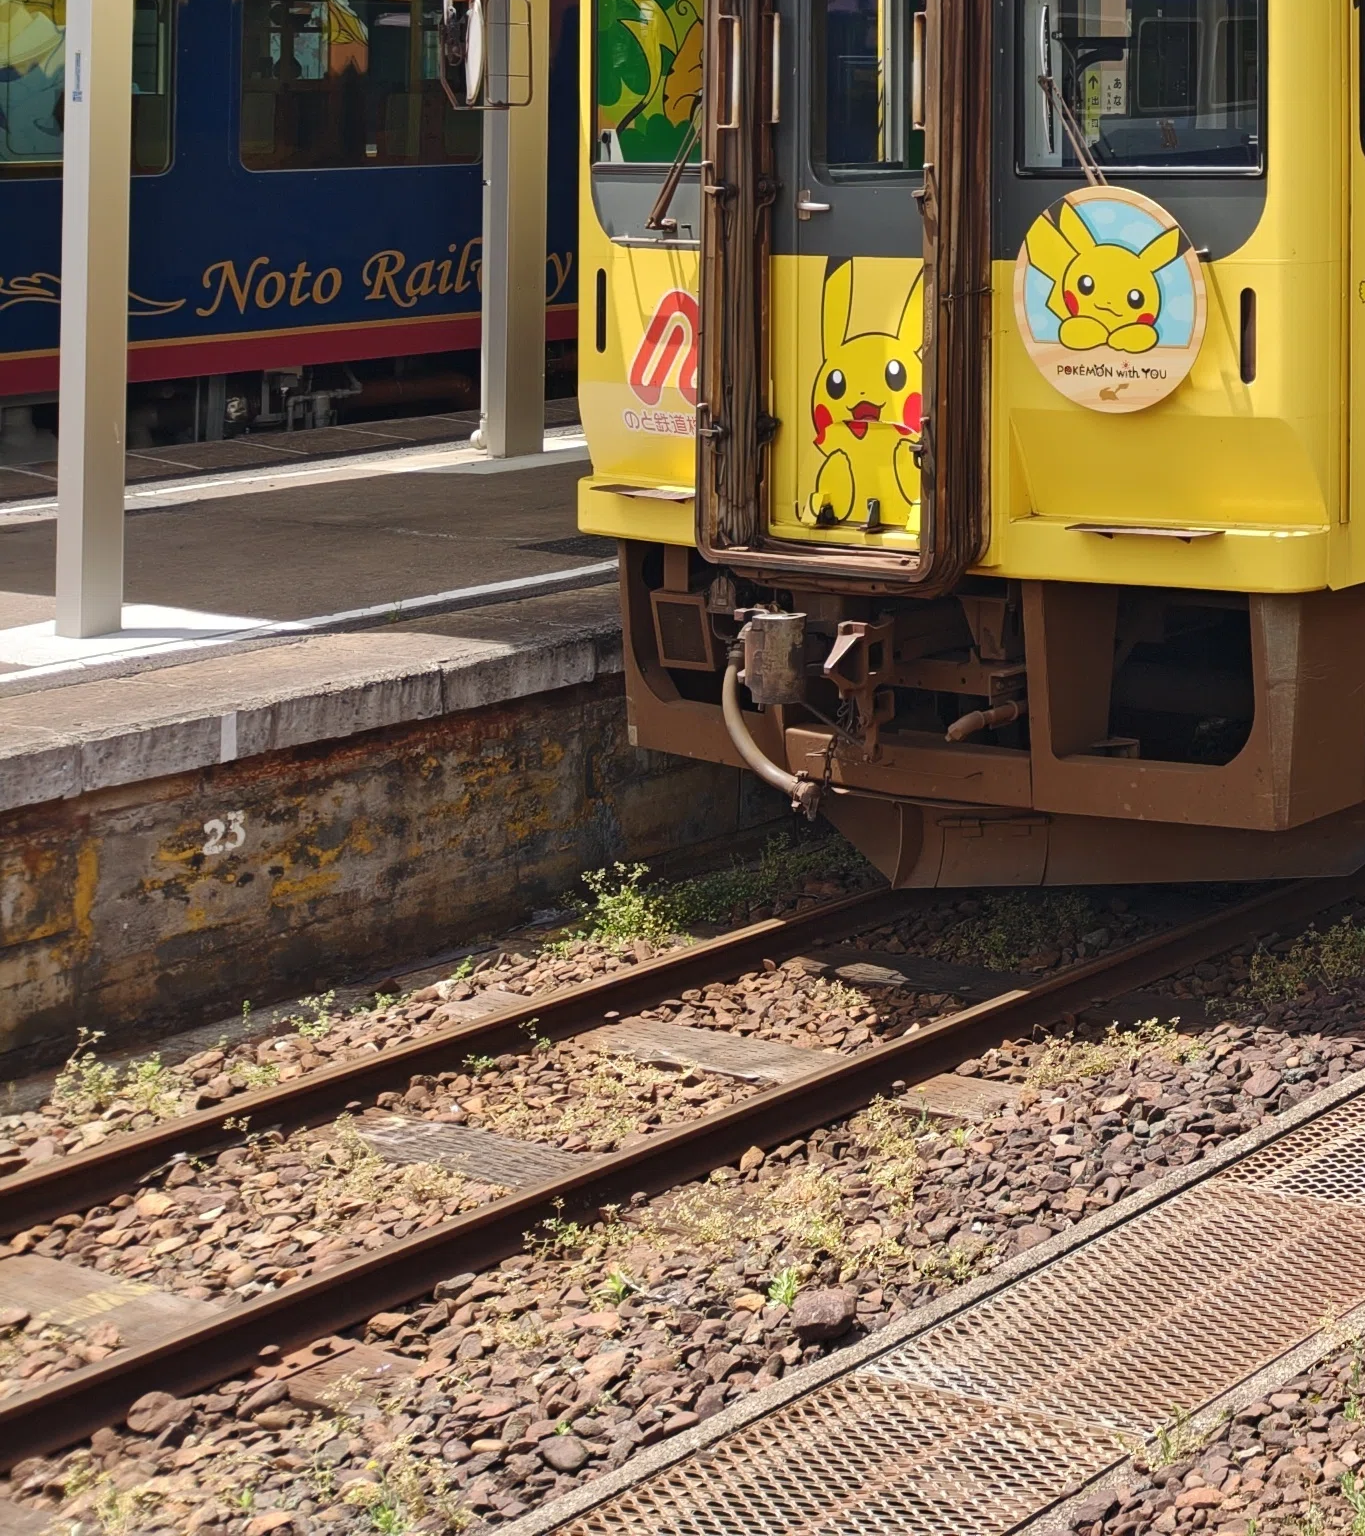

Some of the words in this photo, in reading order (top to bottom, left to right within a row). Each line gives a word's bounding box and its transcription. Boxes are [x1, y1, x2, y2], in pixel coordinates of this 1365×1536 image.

[195, 256, 343, 317] Noto
[362, 237, 573, 308] Raily
[1116, 362, 1140, 378] with
[1141, 368, 1167, 379] YOU
